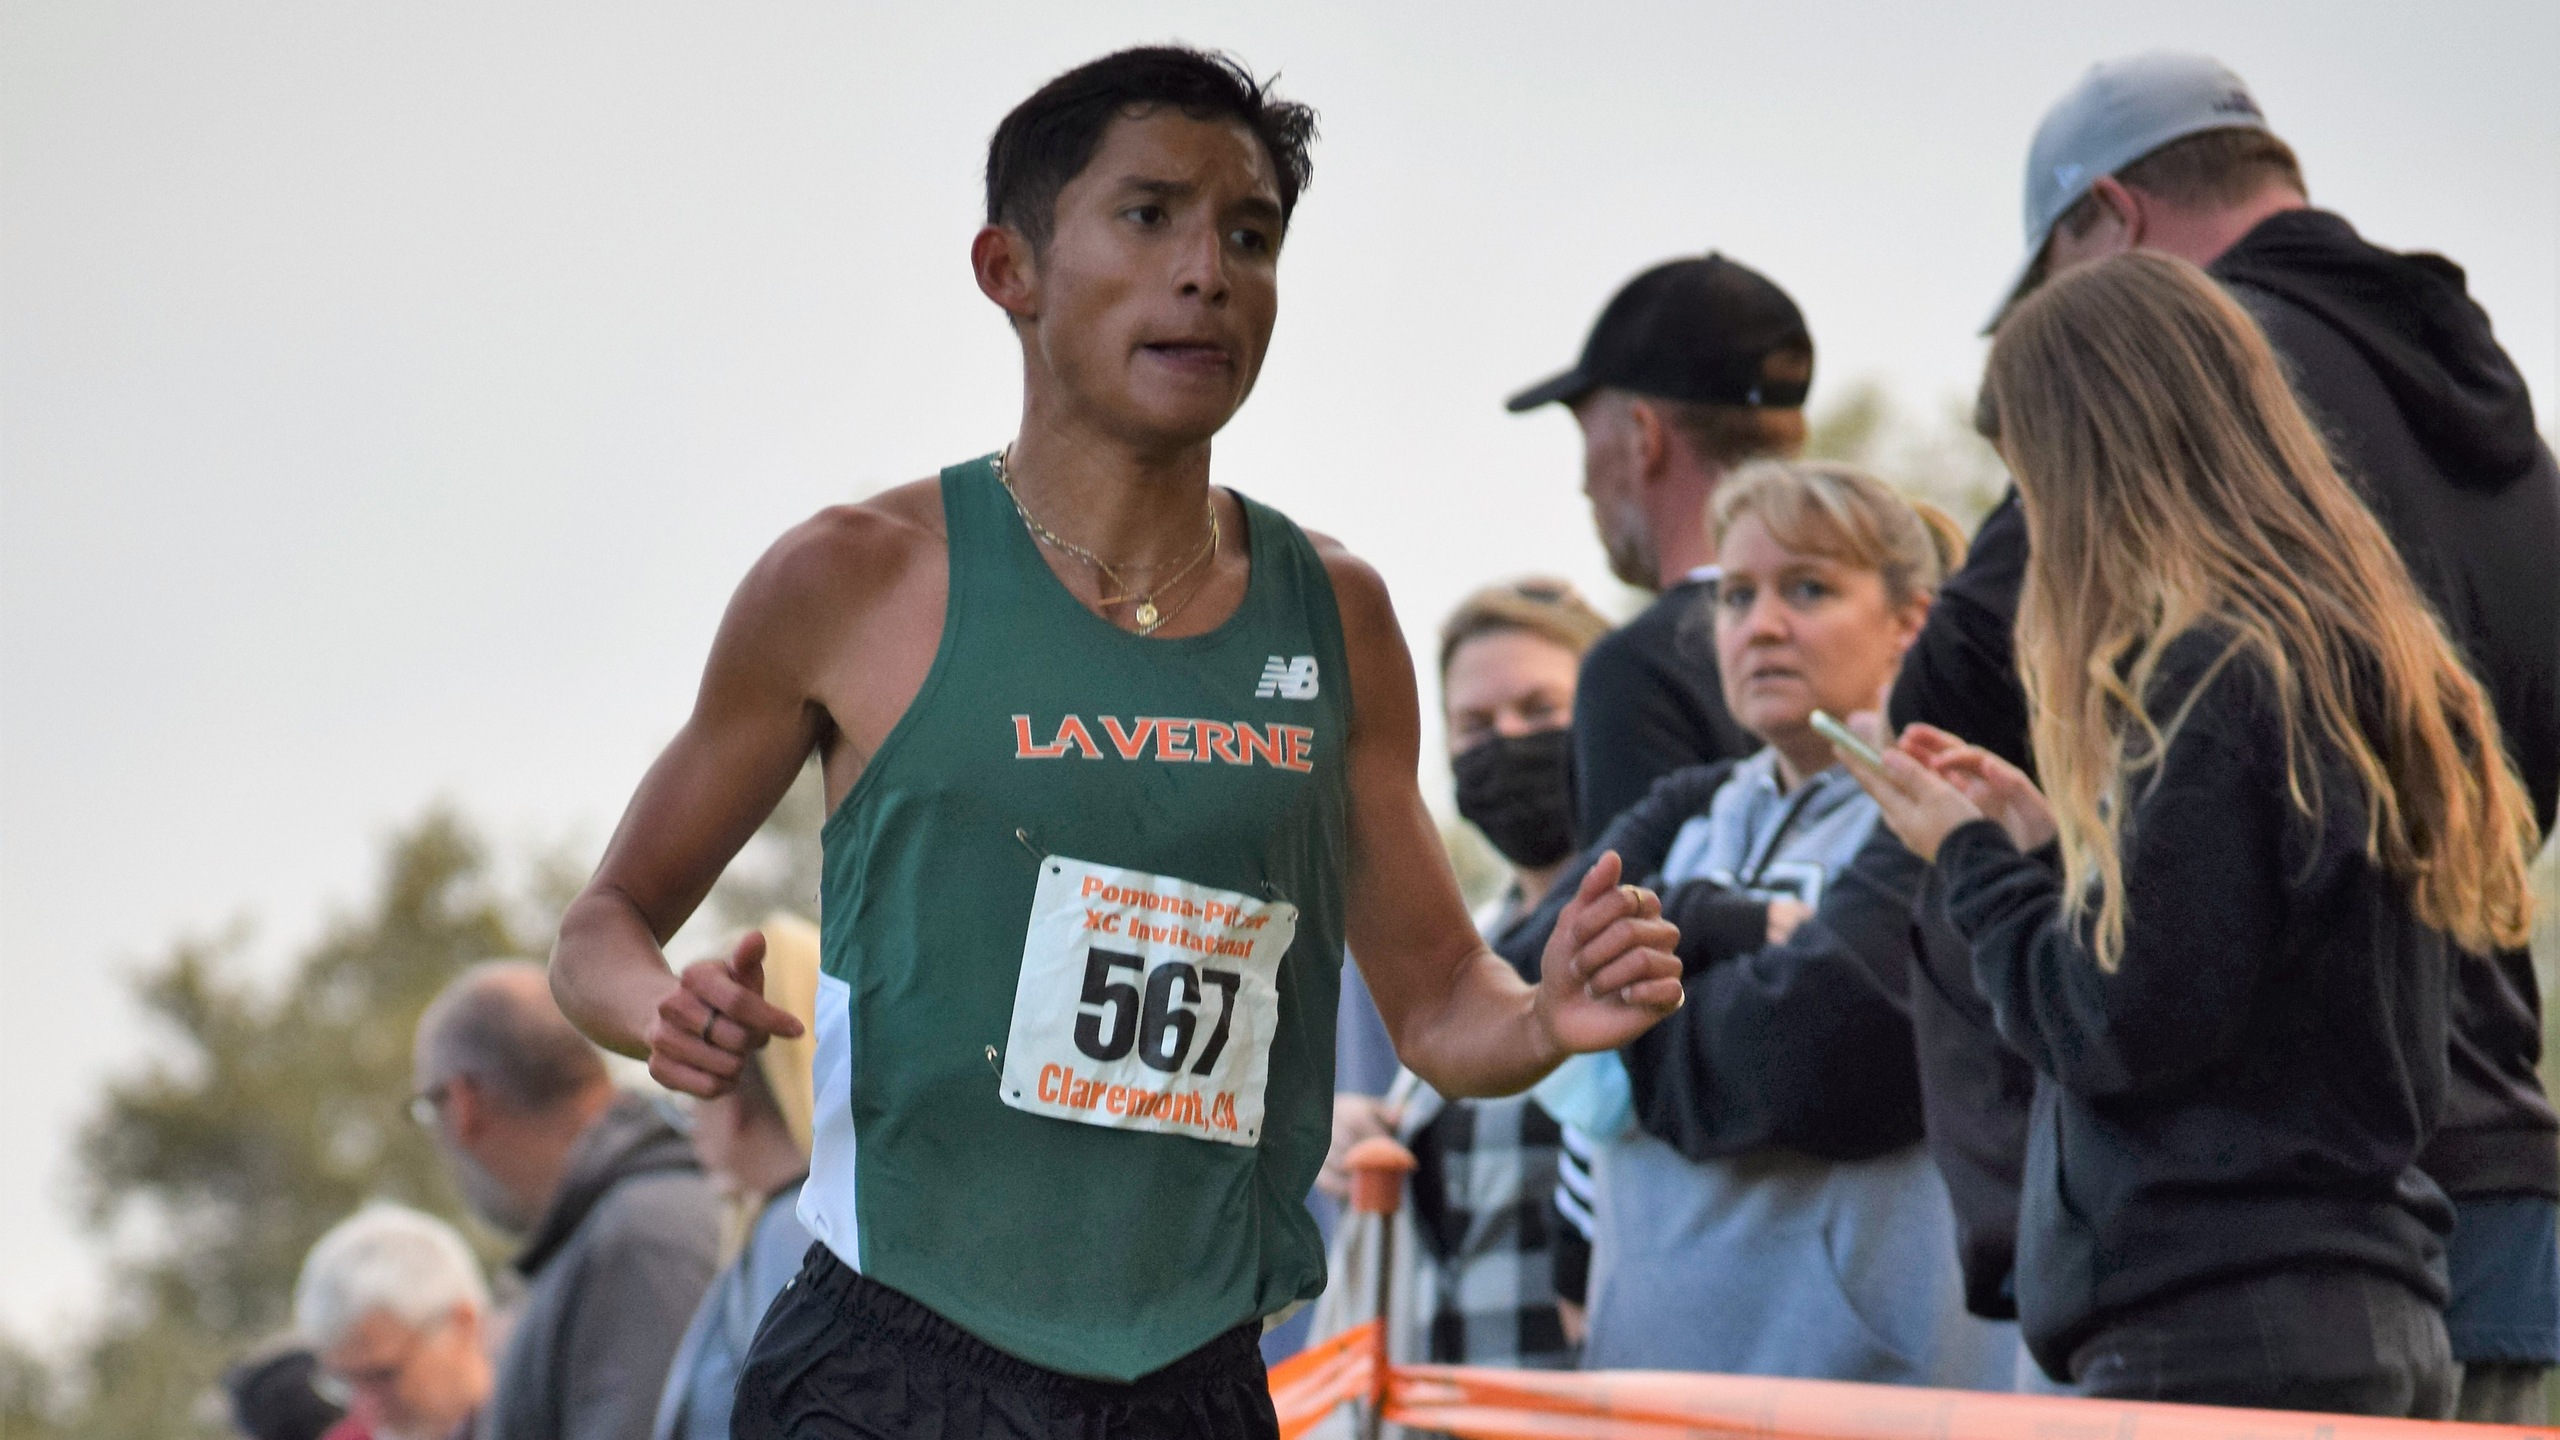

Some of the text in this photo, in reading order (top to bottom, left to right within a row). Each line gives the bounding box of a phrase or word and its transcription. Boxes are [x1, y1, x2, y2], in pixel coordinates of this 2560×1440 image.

[1255, 655, 1319, 700] NB
[1081, 875, 1271, 933] Pomona-Piter
[1083, 907, 1122, 934] XC
[1073, 946, 1241, 1076] 567
